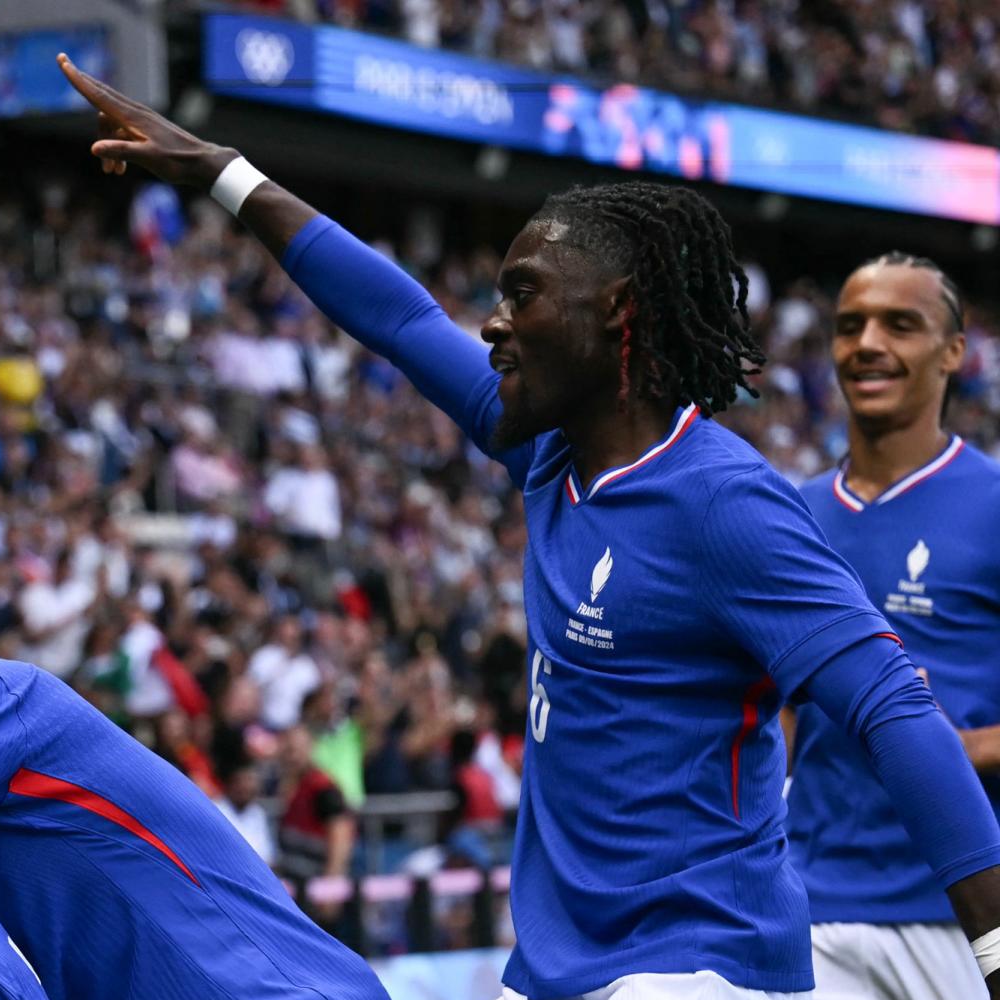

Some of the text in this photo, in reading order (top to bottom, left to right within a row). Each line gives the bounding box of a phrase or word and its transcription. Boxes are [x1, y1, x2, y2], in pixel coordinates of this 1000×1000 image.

[576, 601, 604, 620] FRANCE
[587, 625, 613, 640] ESPAGNE
[530, 649, 551, 743] 6
